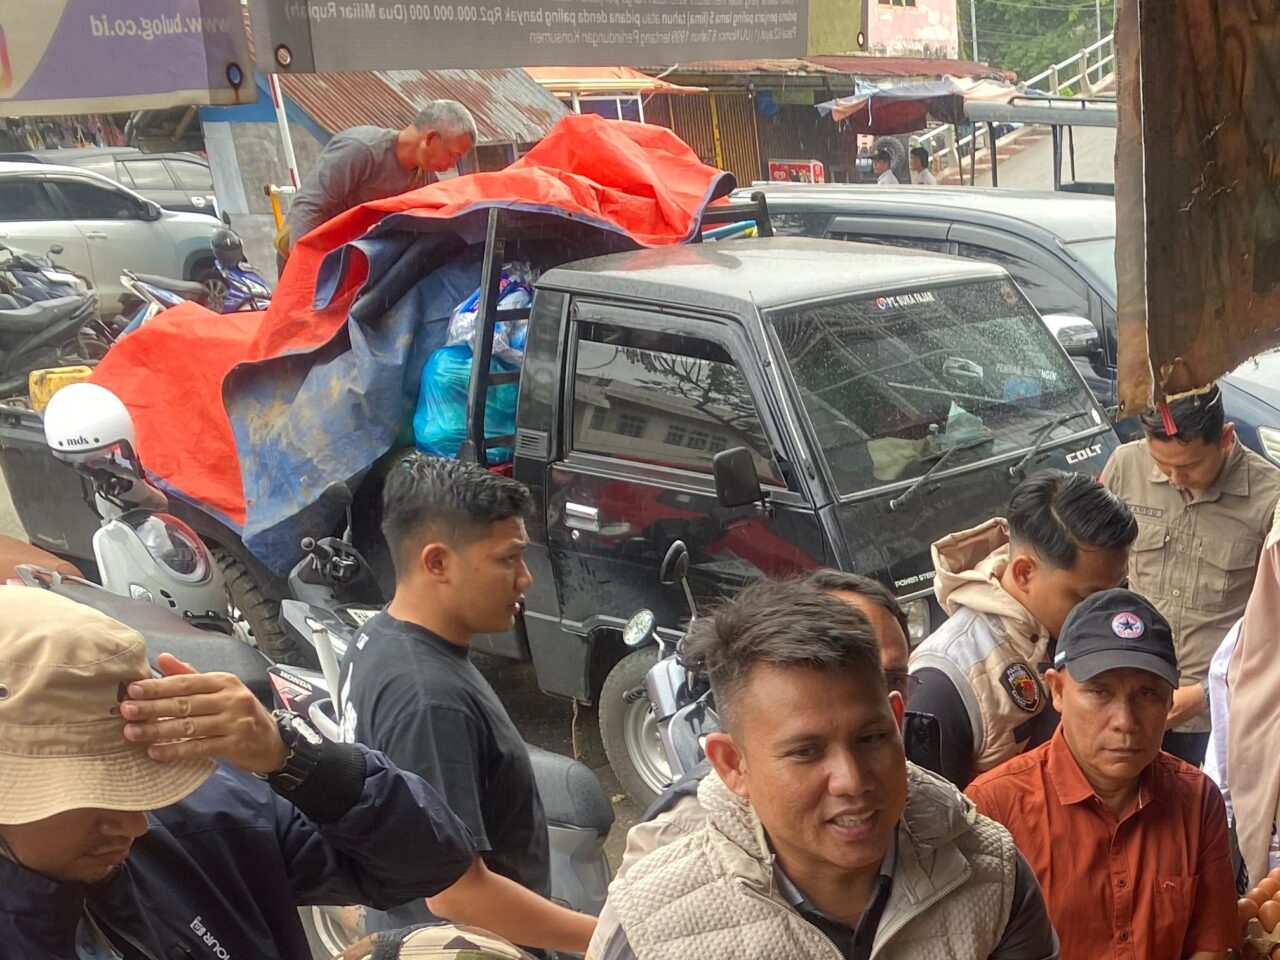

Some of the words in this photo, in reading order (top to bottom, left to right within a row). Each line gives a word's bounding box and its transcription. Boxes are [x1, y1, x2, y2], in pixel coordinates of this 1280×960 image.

[66, 435, 89, 446] mds
[1065, 444, 1105, 465] COLT
[894, 575, 919, 588] POWER
[280, 671, 313, 691] HONDA
